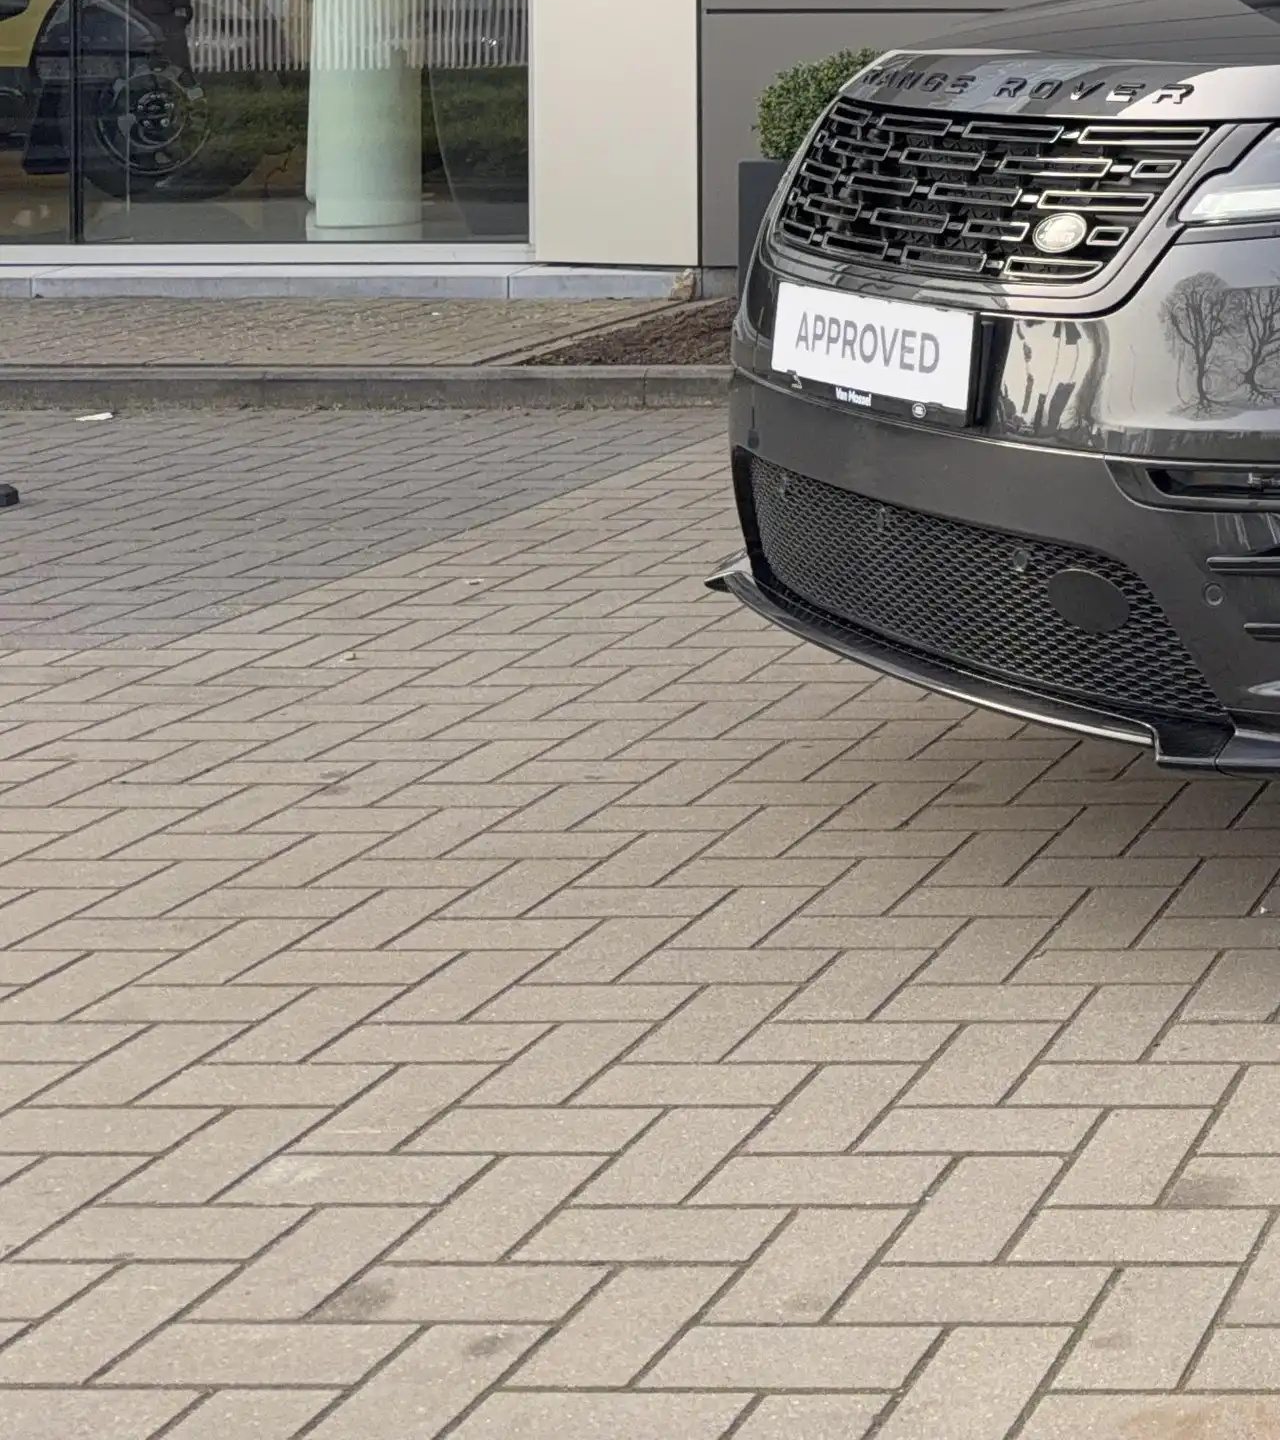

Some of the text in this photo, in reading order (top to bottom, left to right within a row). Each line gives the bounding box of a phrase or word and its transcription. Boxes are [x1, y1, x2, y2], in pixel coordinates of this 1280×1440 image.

[862, 67, 1196, 106] RANGE ROVER
[794, 311, 941, 374] APPROVED
[835, 386, 848, 402] Van
